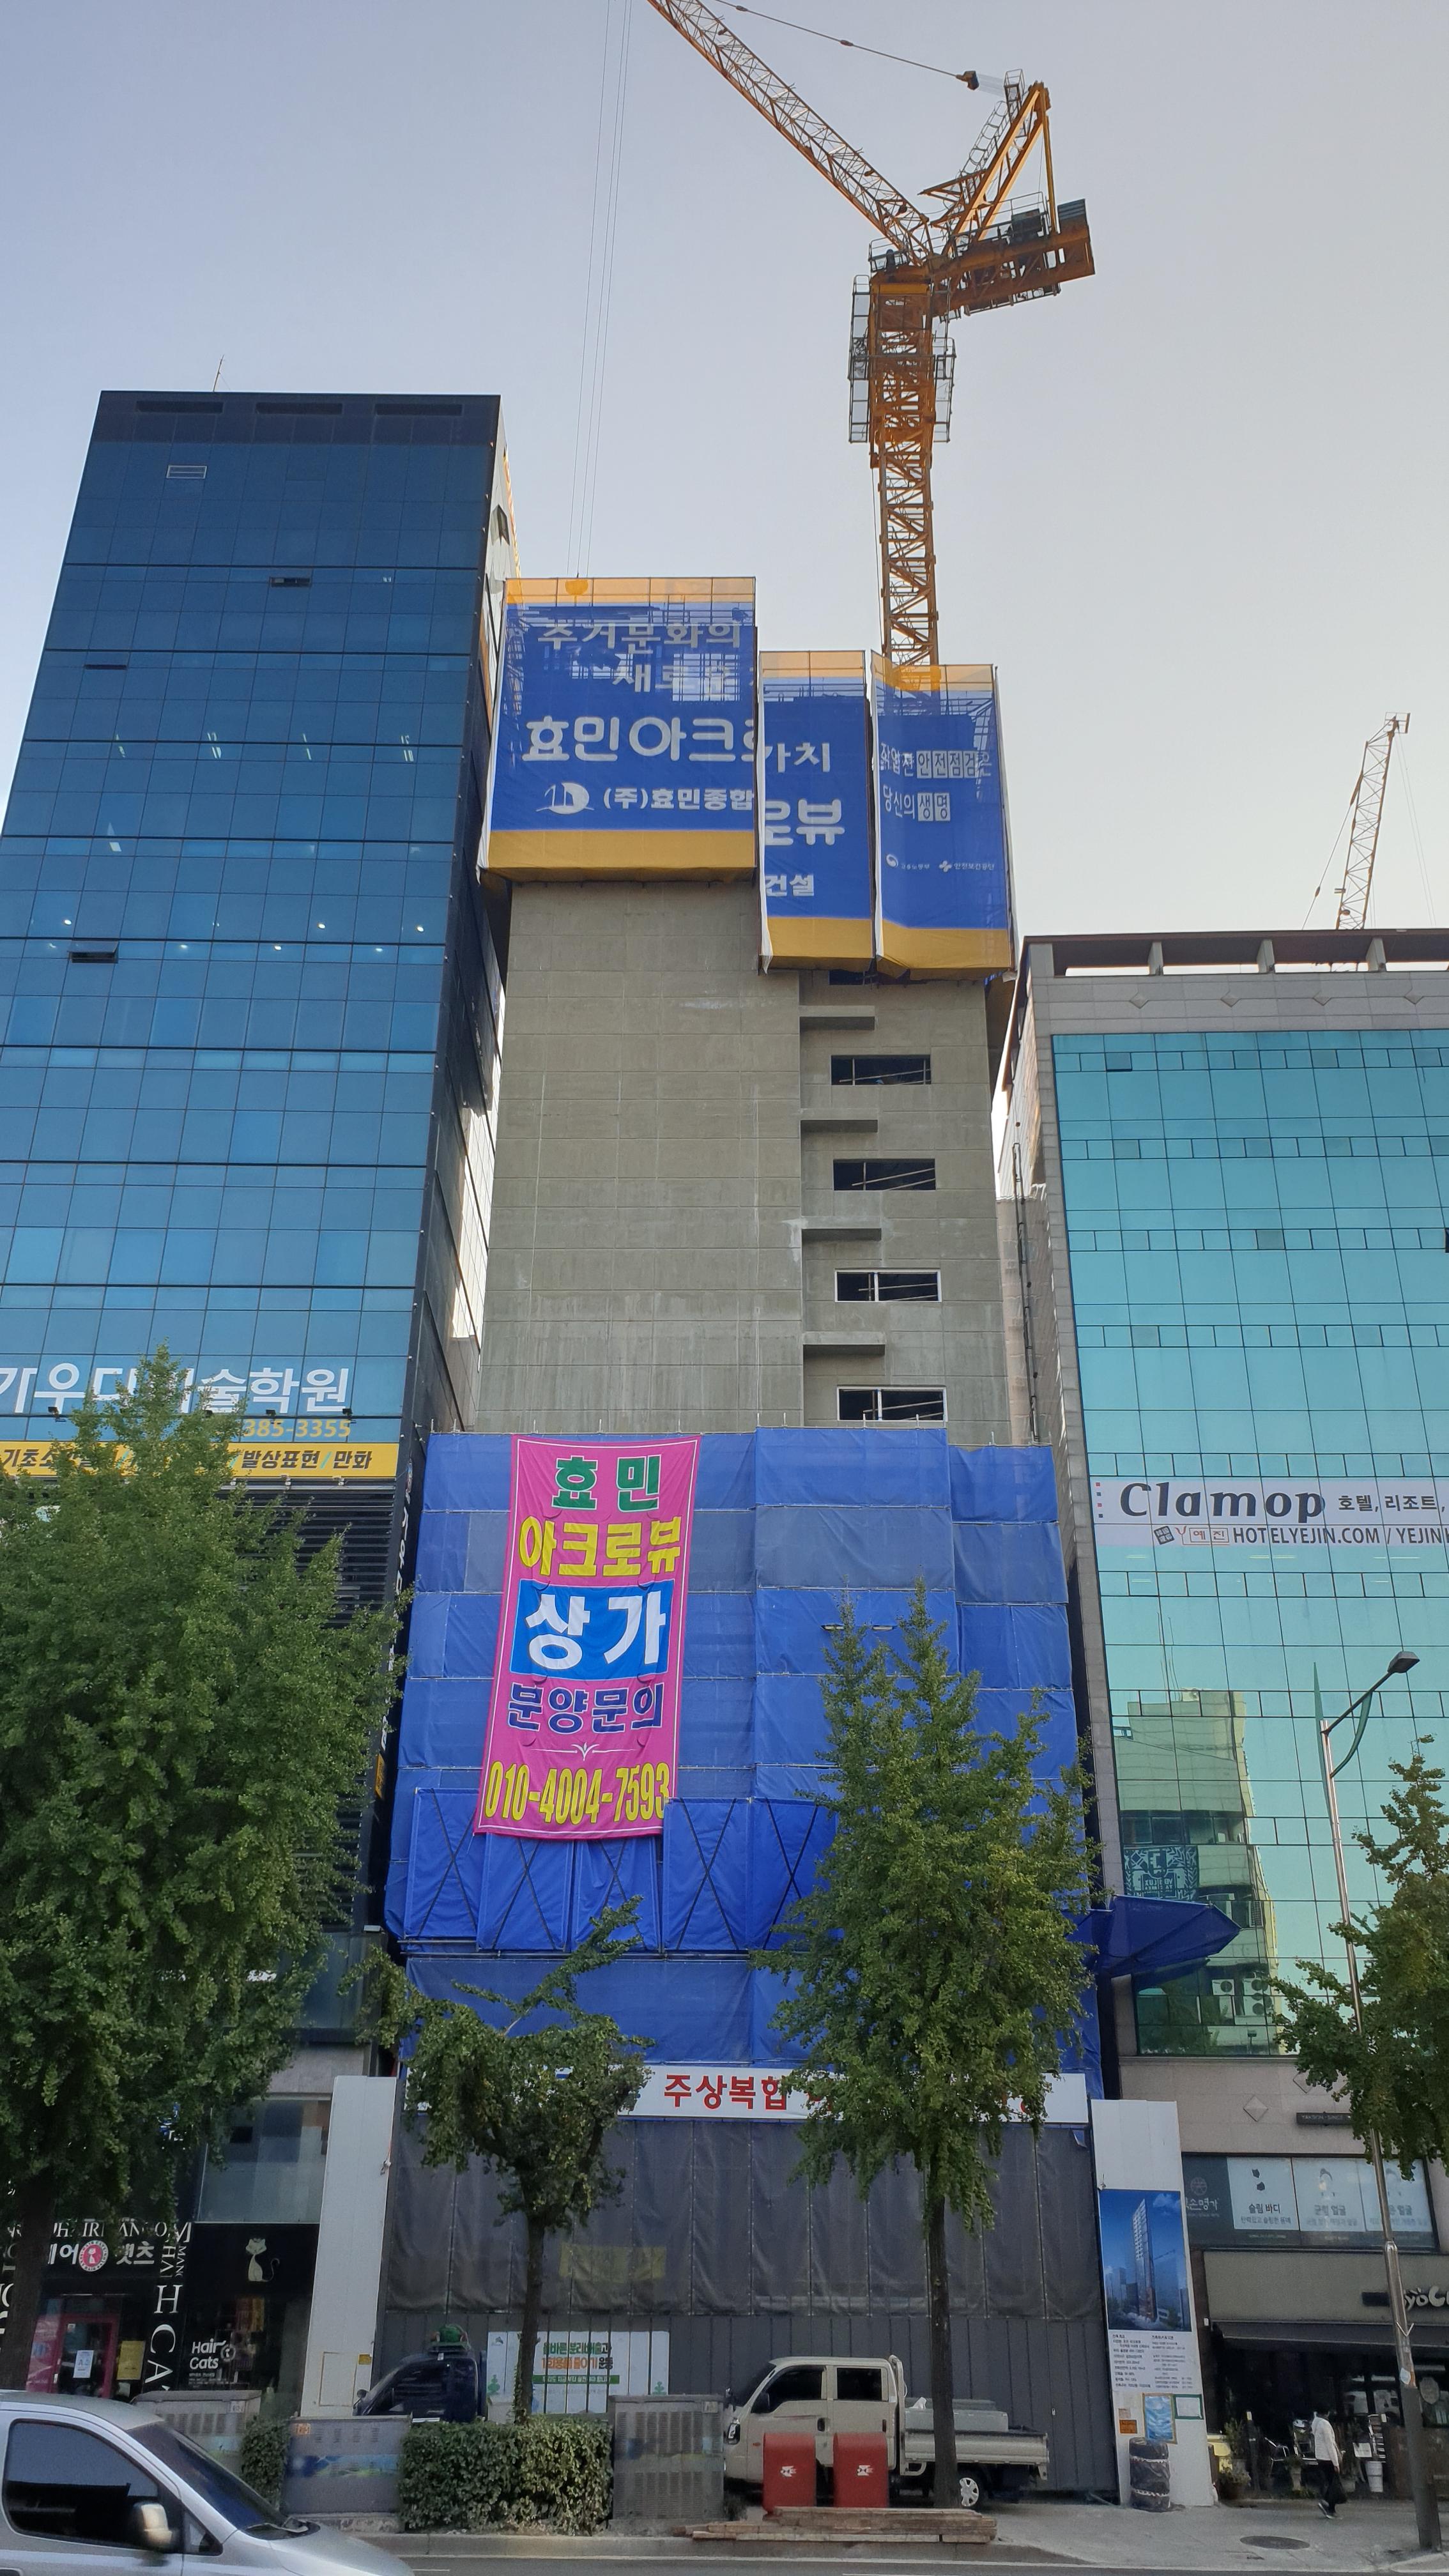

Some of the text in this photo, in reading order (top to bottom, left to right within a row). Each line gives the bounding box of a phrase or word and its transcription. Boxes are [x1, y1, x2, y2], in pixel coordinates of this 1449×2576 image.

[538, 624, 740, 654] 주거문화의
[883, 785, 950, 821] 당신의 생명
[765, 874, 815, 896] 건설
[241, 1450, 321, 1469] 발상표현
[334, 1451, 372, 1469] 만화
[1121, 1482, 1326, 1524] Clamop
[1338, 1495, 1378, 1512] 호텔,
[518, 1515, 682, 1576] 아크로뷰
[1233, 1527, 1380, 1544] HOTELYEJIN.COM
[507, 1682, 664, 1734] 분양문의
[485, 1760, 671, 1825] 010-4004-7593
[1248, 2203, 1281, 2214] 슬림 바디
[192, 2338, 227, 2354] Hair
[189, 2356, 219, 2370] Cats
